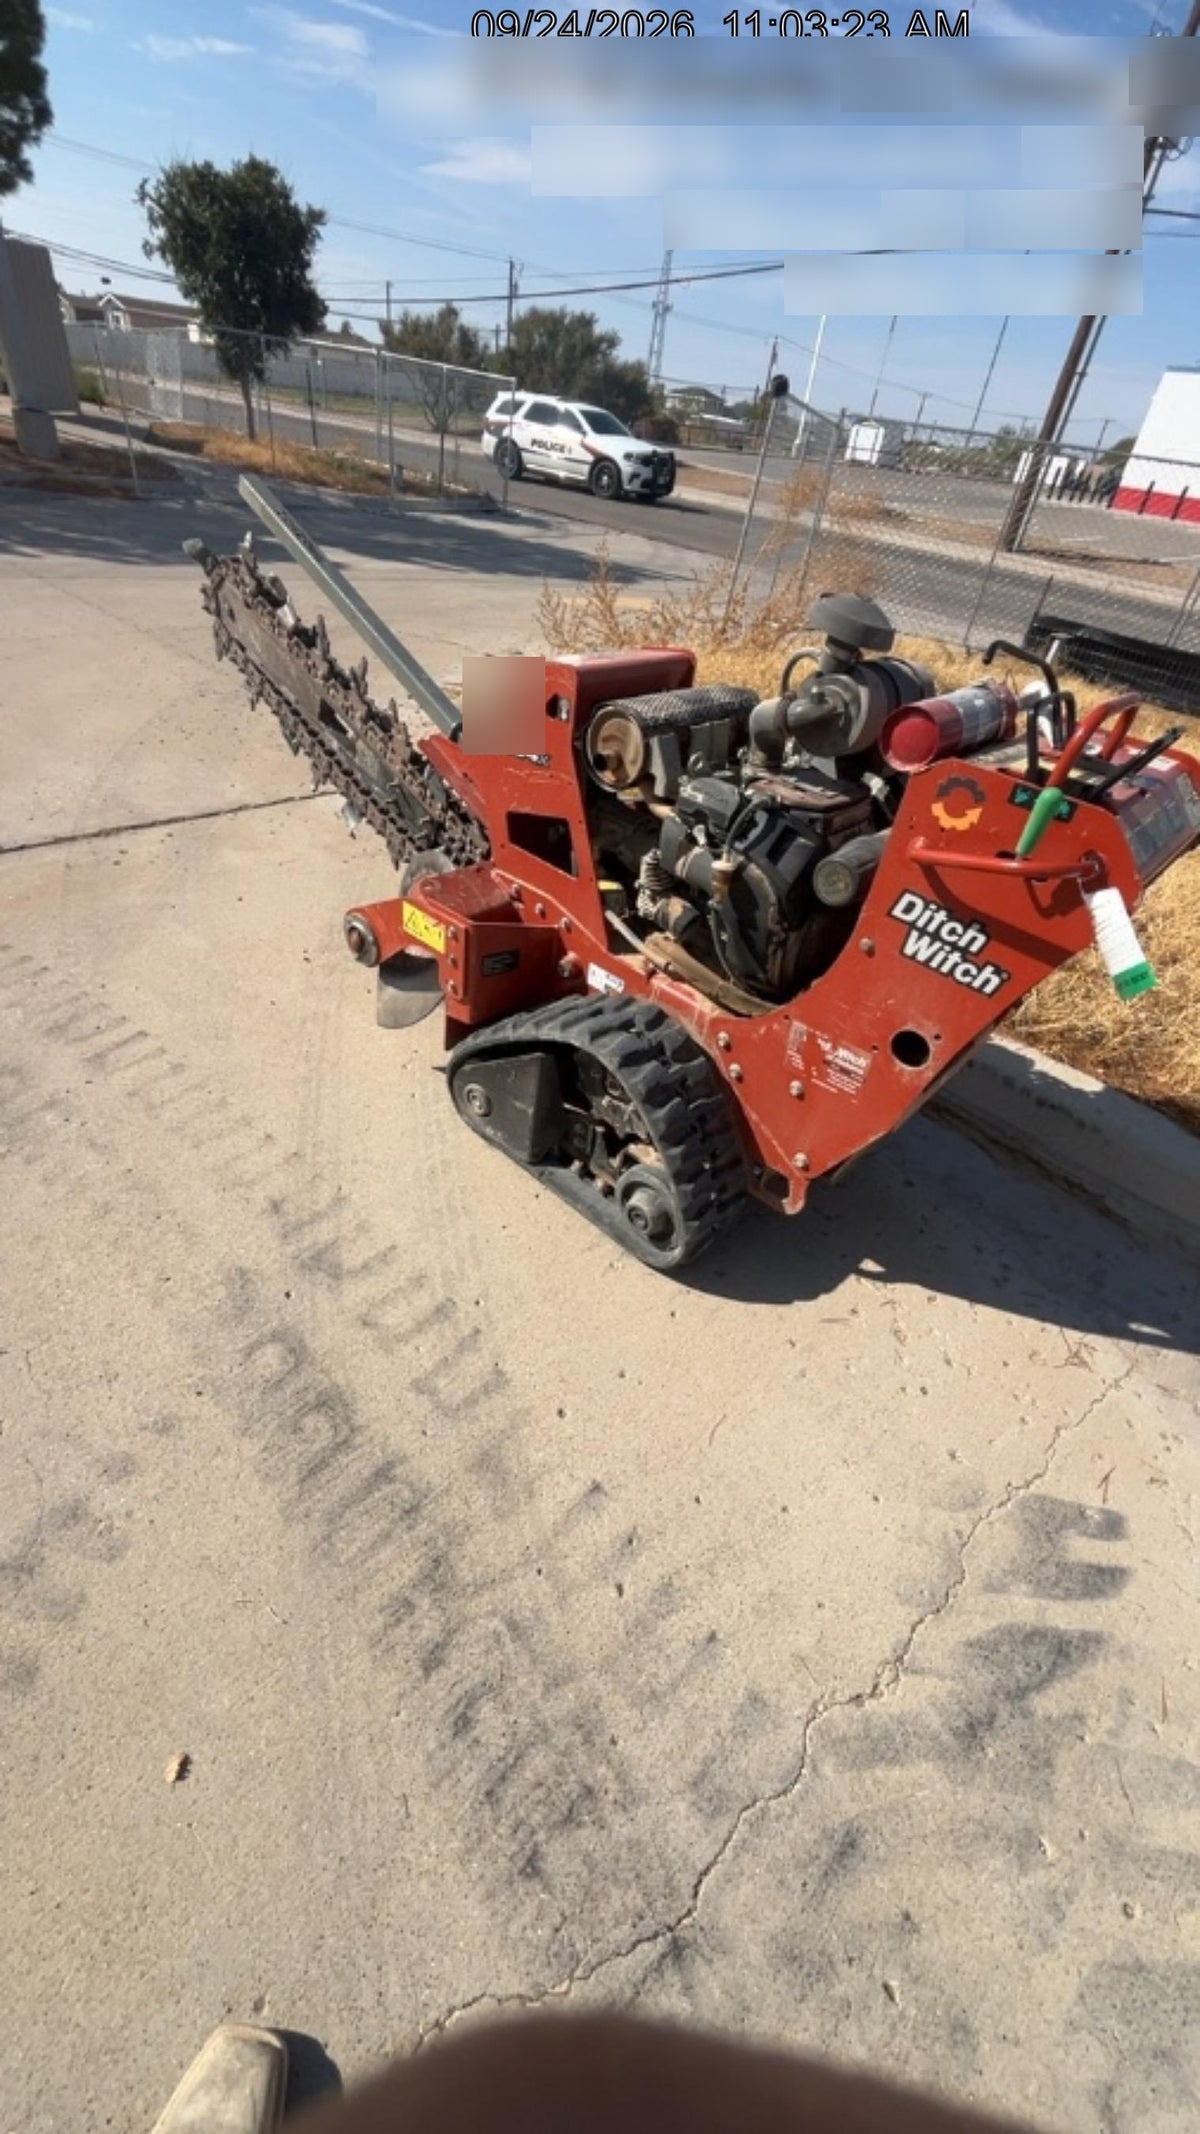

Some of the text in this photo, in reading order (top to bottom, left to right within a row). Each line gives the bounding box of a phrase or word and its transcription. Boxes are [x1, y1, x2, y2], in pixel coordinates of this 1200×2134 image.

[531, 438, 565, 454] POLICE
[890, 892, 988, 953] Ditch
[903, 929, 1004, 995] Witch
